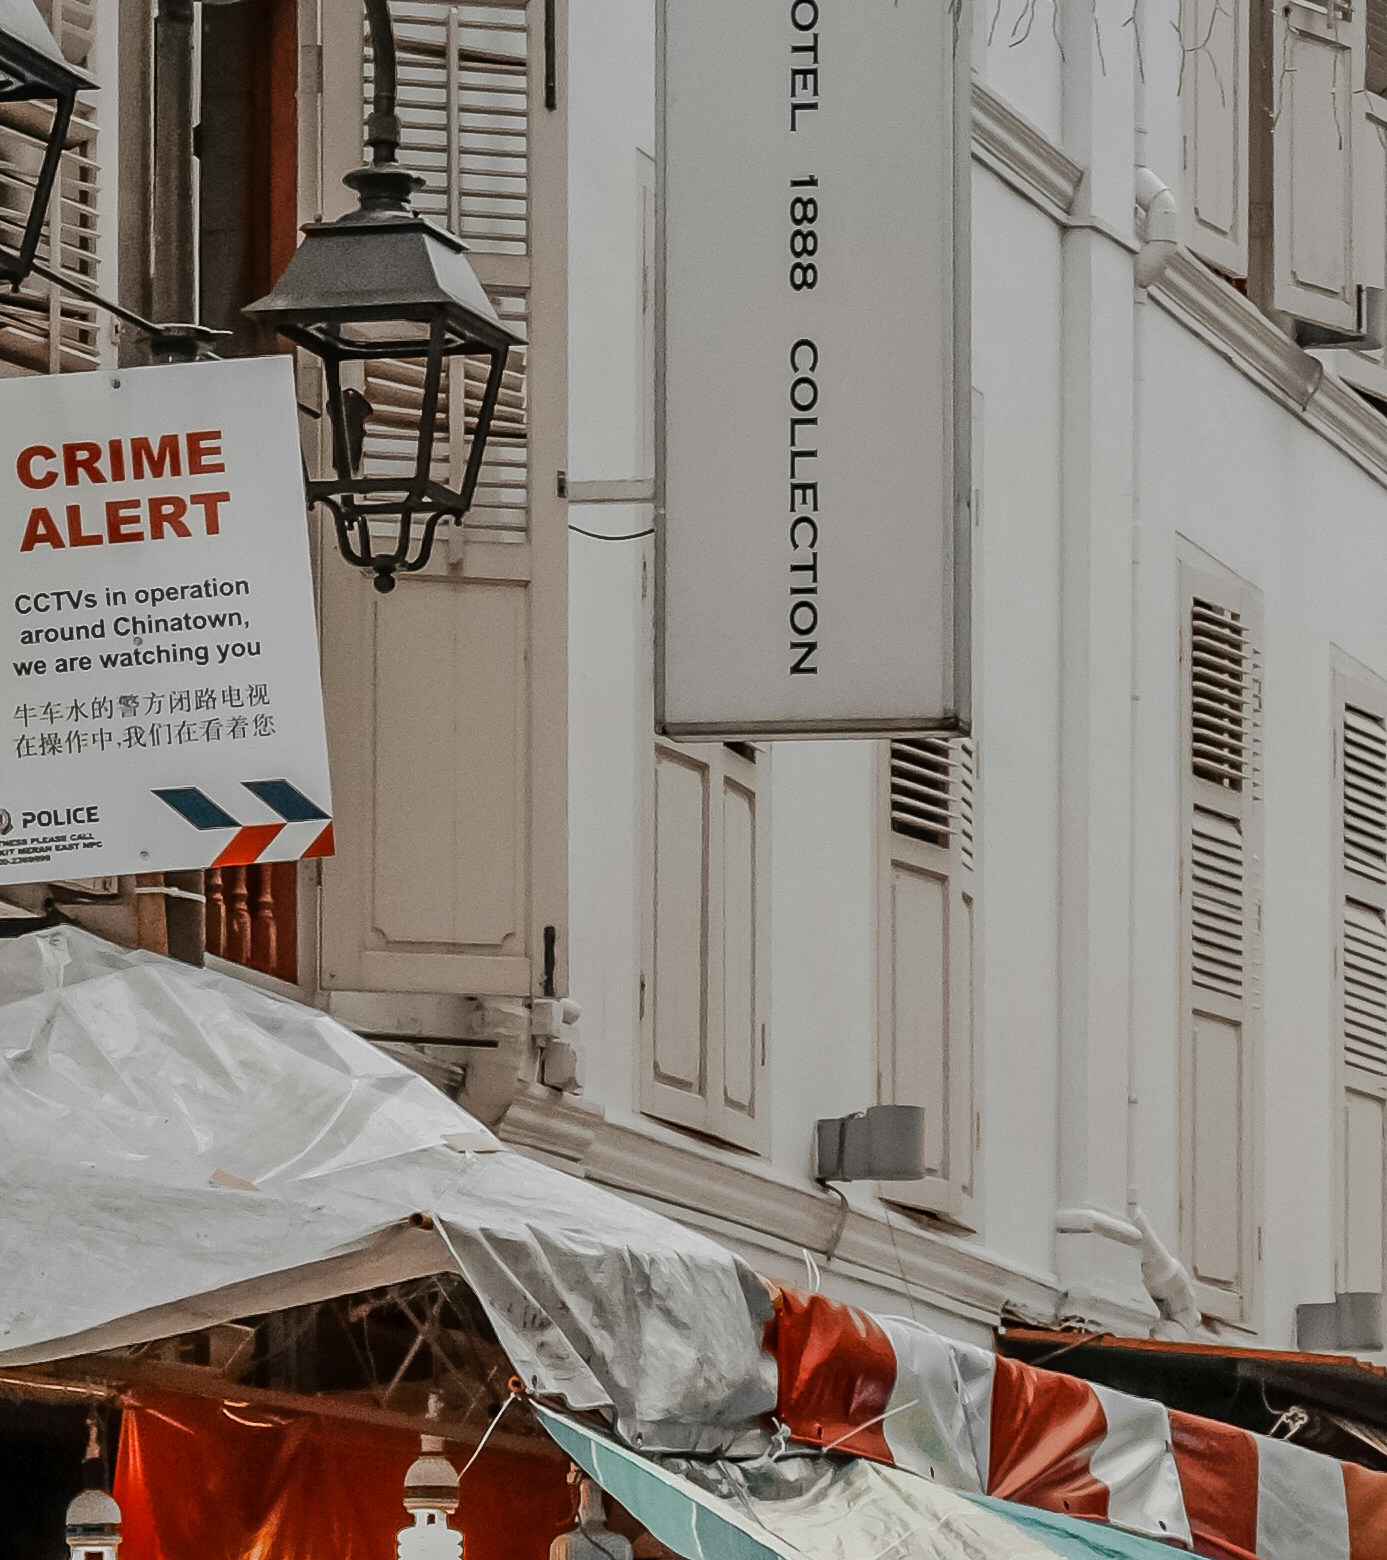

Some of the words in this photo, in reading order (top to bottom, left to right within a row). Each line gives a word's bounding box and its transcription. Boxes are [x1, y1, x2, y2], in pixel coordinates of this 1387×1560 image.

[789, 175, 820, 292] 1888
[16, 429, 227, 491] CRIME
[19, 490, 232, 553] ALERT
[789, 338, 820, 677] COLLECTION
[14, 589, 98, 616] CCTVs
[105, 586, 127, 609] in
[133, 577, 251, 614] operation
[19, 619, 105, 646] around
[112, 607, 251, 638] Chinatown,
[12, 657, 48, 677] we
[54, 654, 93, 673] are
[99, 641, 210, 670] watching
[216, 639, 262, 665] you
[12, 682, 272, 728] 牛车水的警方闭路电视
[21, 805, 100, 829] POLICE
[18, 846, 52, 854] MERAH
[54, 842, 80, 851] EAST
[82, 841, 103, 849] NPC
[30, 835, 67, 844] PLEASE
[69, 833, 95, 841] CALL
